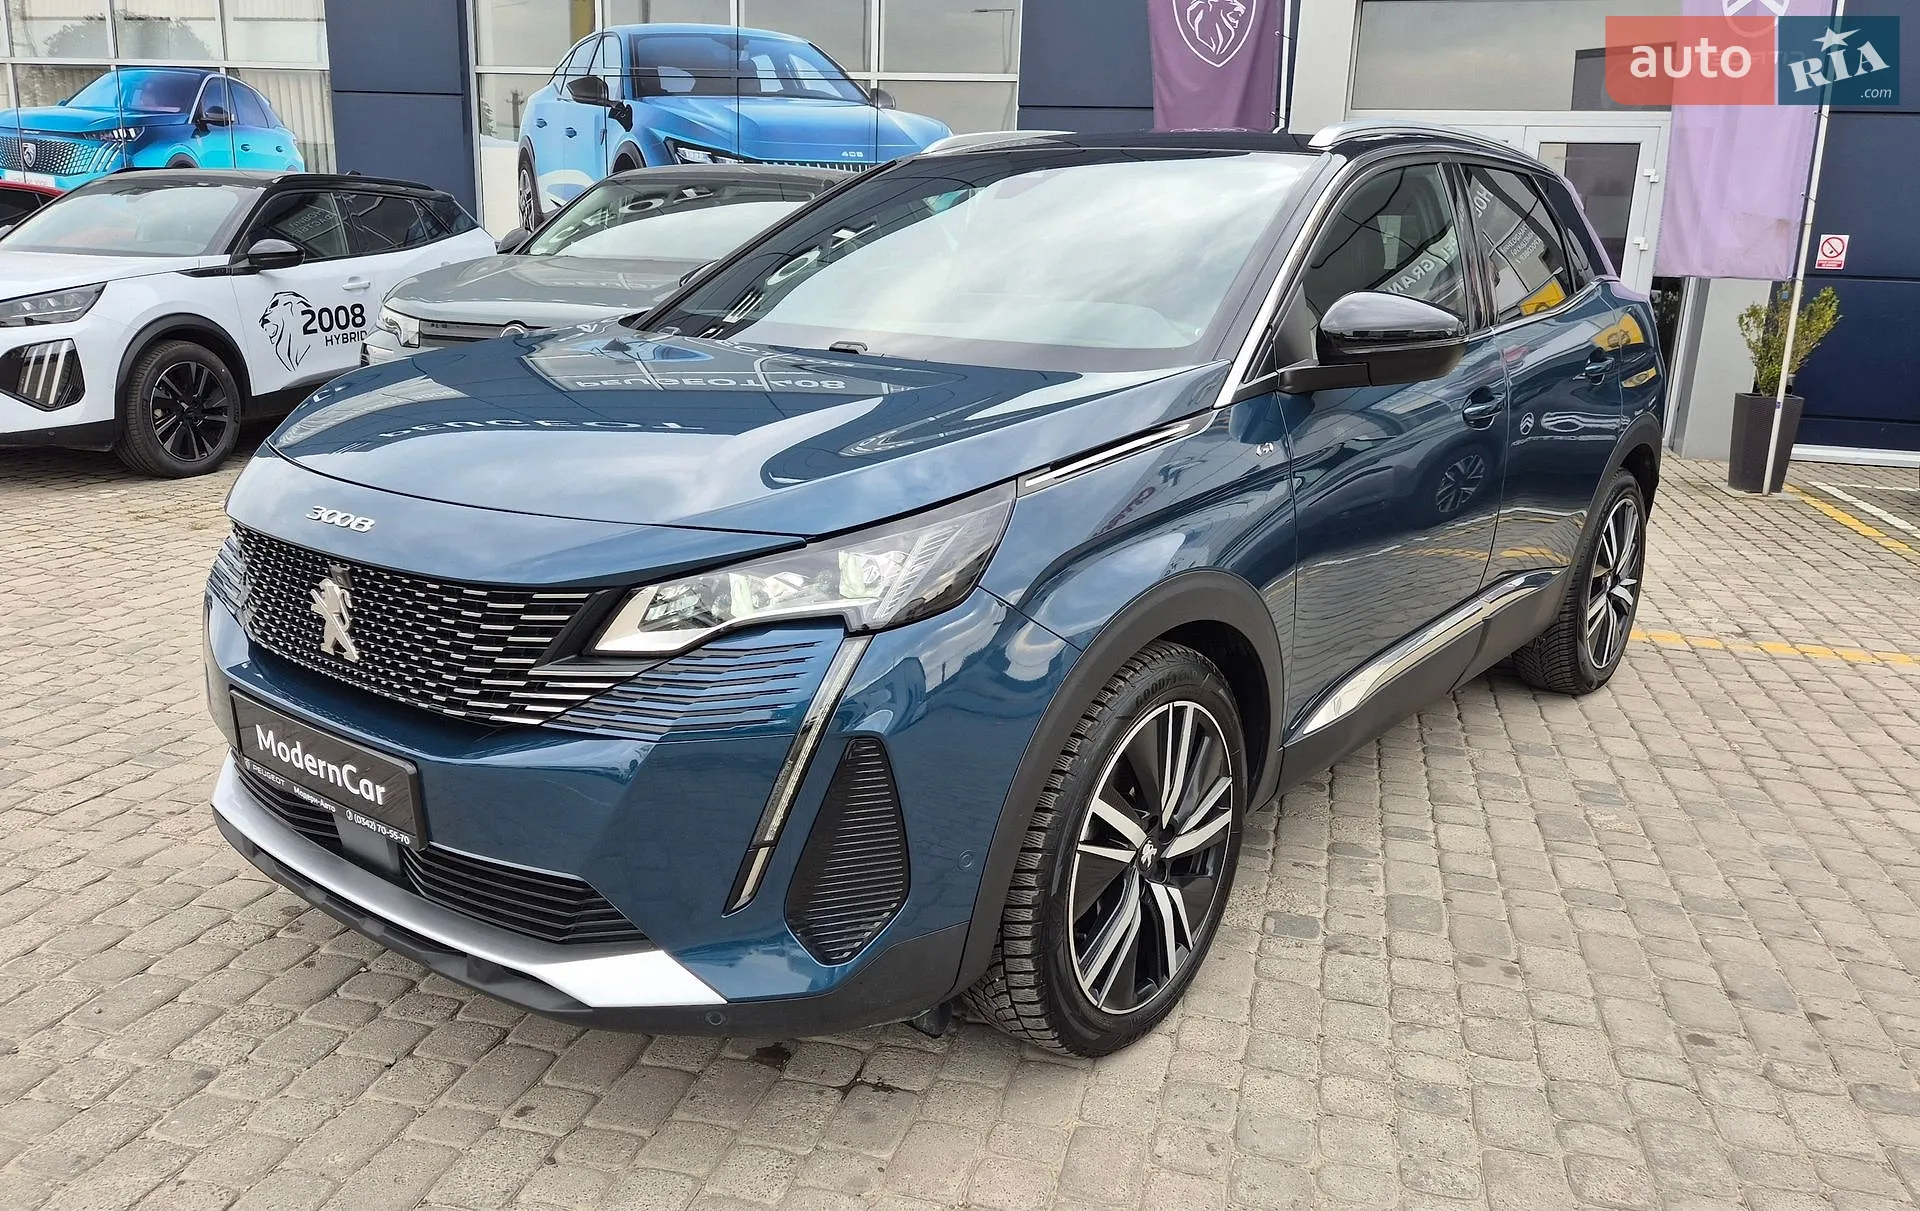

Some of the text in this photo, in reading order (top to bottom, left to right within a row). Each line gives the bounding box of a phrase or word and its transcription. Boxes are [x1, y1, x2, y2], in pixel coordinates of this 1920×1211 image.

[301, 303, 366, 336] 2008
[325, 330, 367, 347] HYBRID
[304, 505, 376, 533] 3008
[251, 763, 286, 787] PEUGEOT
[255, 723, 386, 806] ModernCar
[353, 811, 411, 845] (0342) 70-55-70
